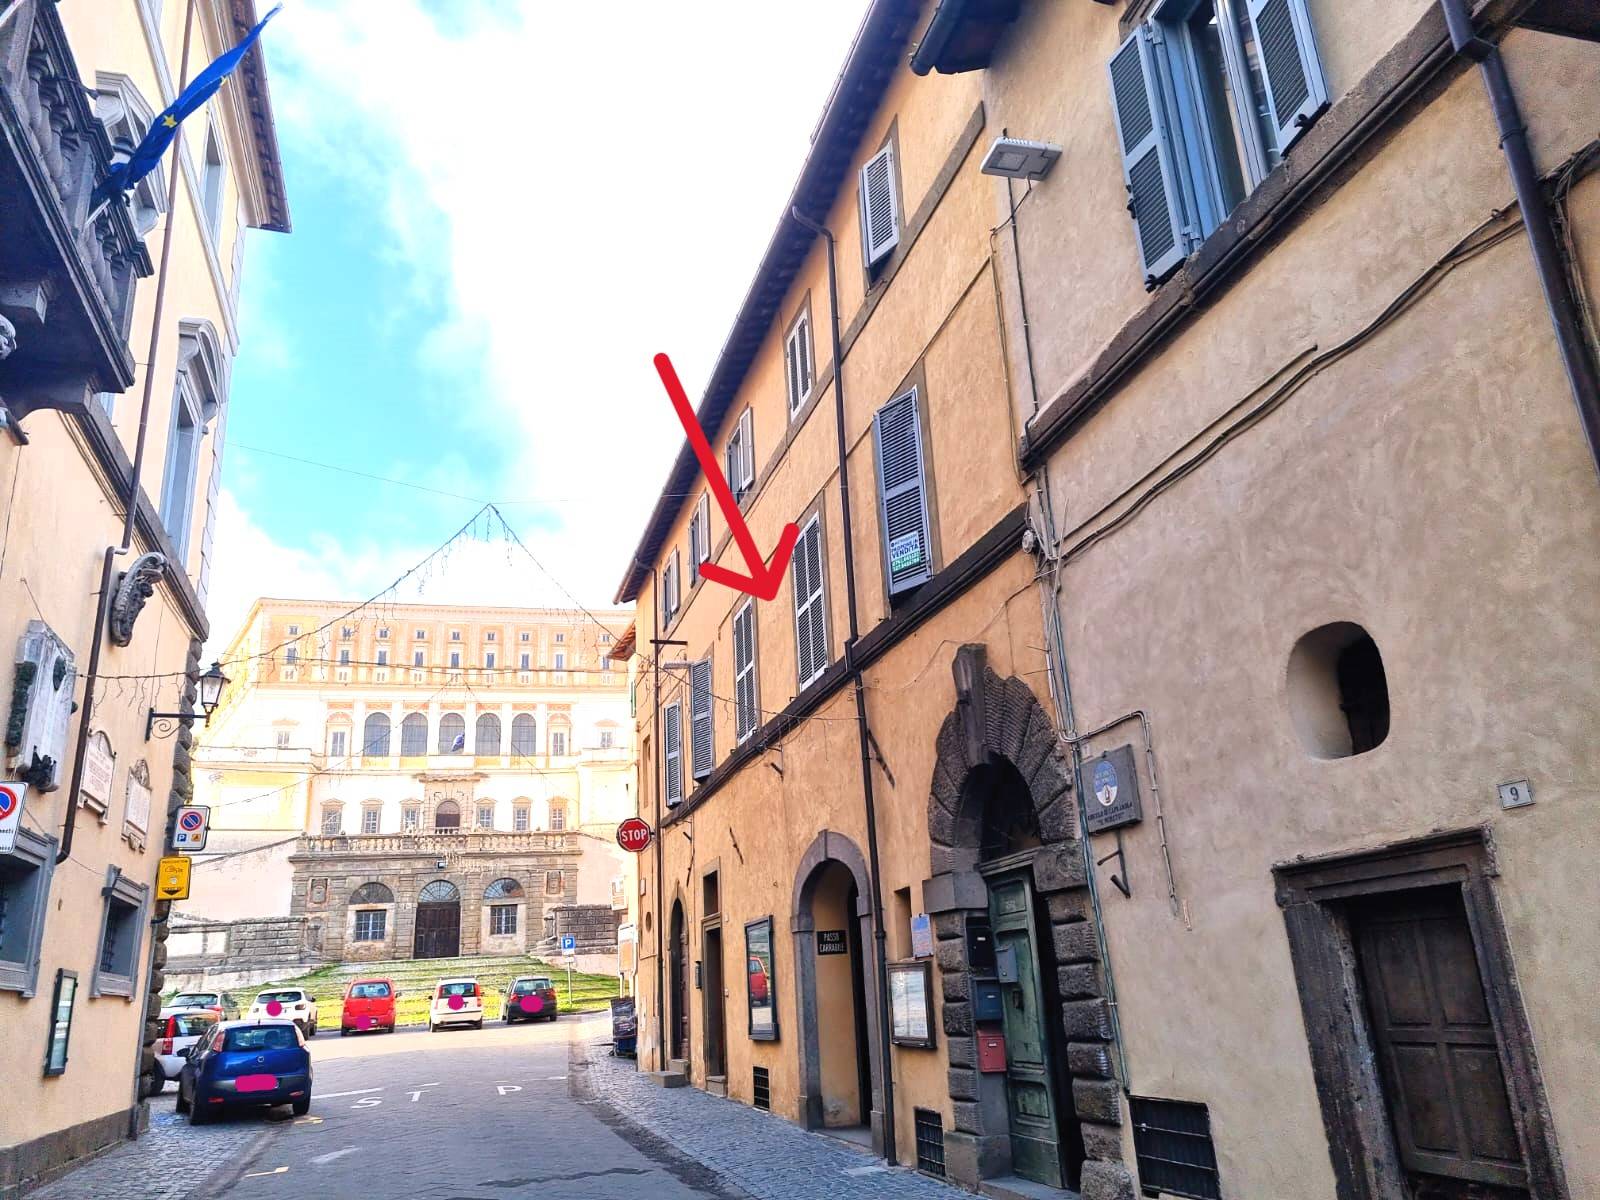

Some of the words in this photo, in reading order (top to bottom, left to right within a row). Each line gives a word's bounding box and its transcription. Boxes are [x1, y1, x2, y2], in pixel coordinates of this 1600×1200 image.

[892, 544, 919, 559] VENDITA
[1510, 786, 1519, 801] 9
[621, 828, 647, 842] STOP
[565, 939, 571, 948] P
[823, 933, 840, 942] PASSO
[819, 943, 844, 953] CARRABILE
